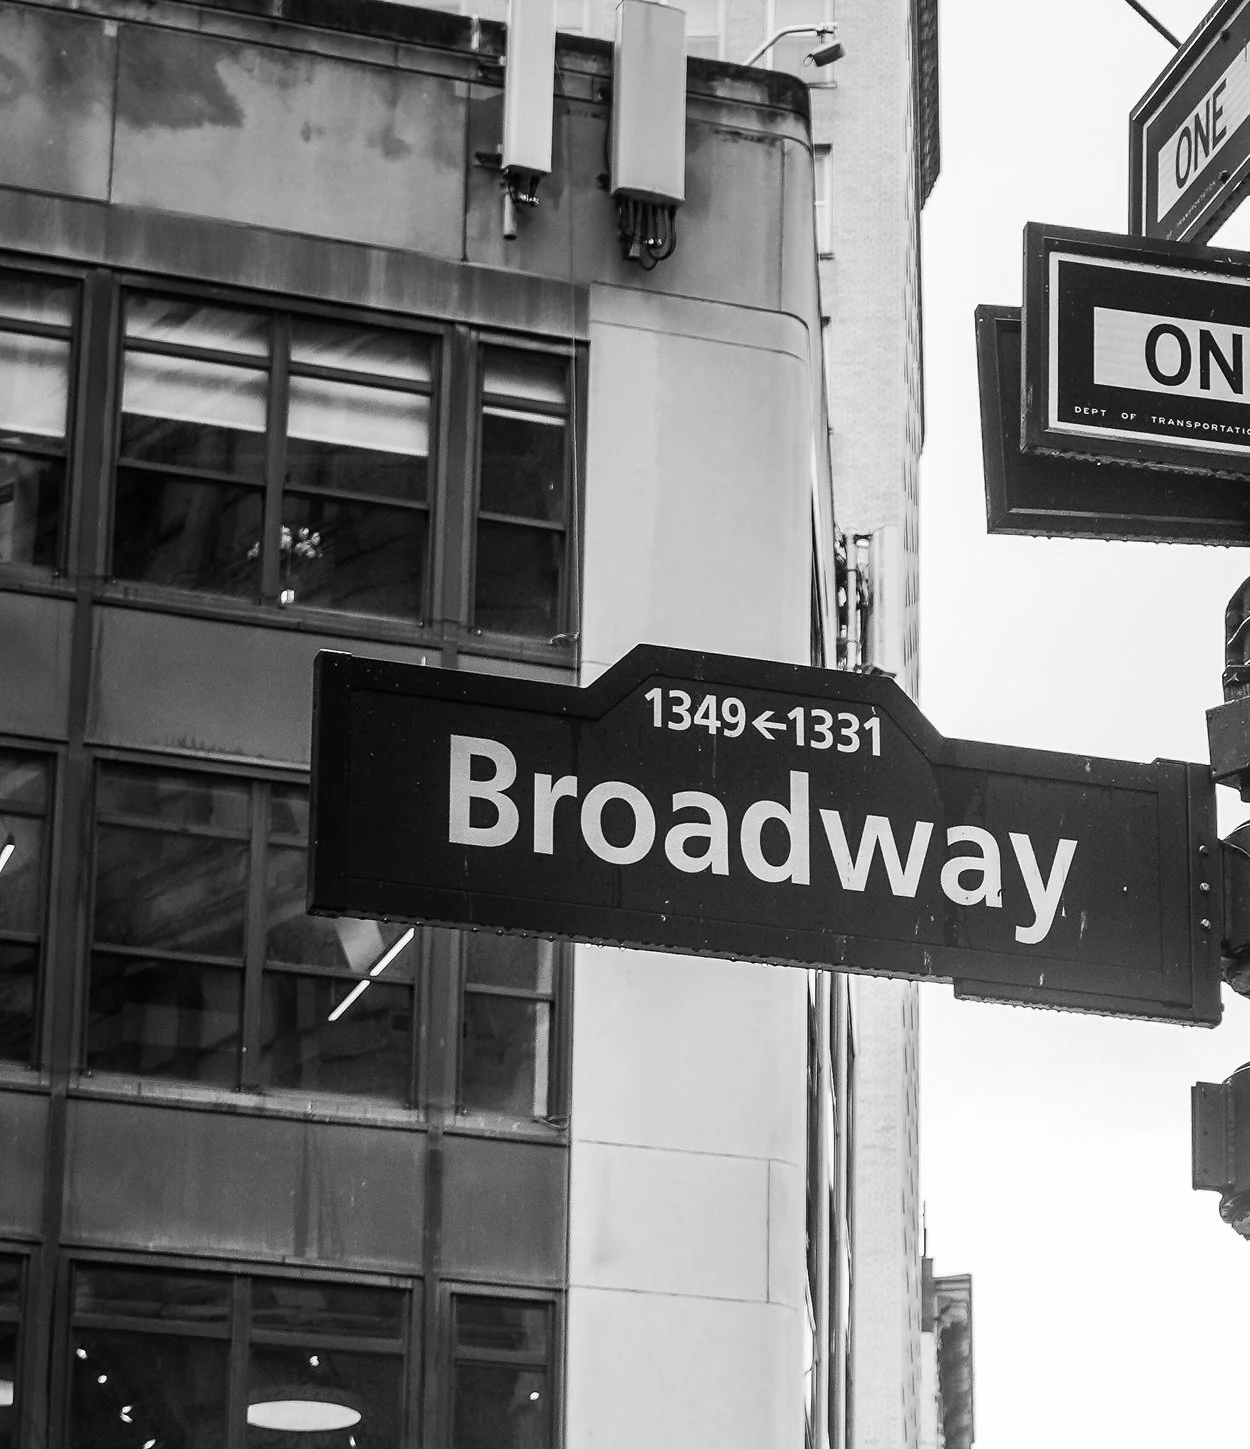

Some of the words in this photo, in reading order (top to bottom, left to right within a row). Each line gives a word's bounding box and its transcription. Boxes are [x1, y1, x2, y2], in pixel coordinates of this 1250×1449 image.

[1175, 86, 1228, 189] ONE
[1074, 405, 1107, 417] DEPT
[1121, 412, 1137, 421] OF
[643, 686, 747, 740] 1349
[787, 705, 883, 757] 1331
[448, 734, 1079, 945] Broadway
